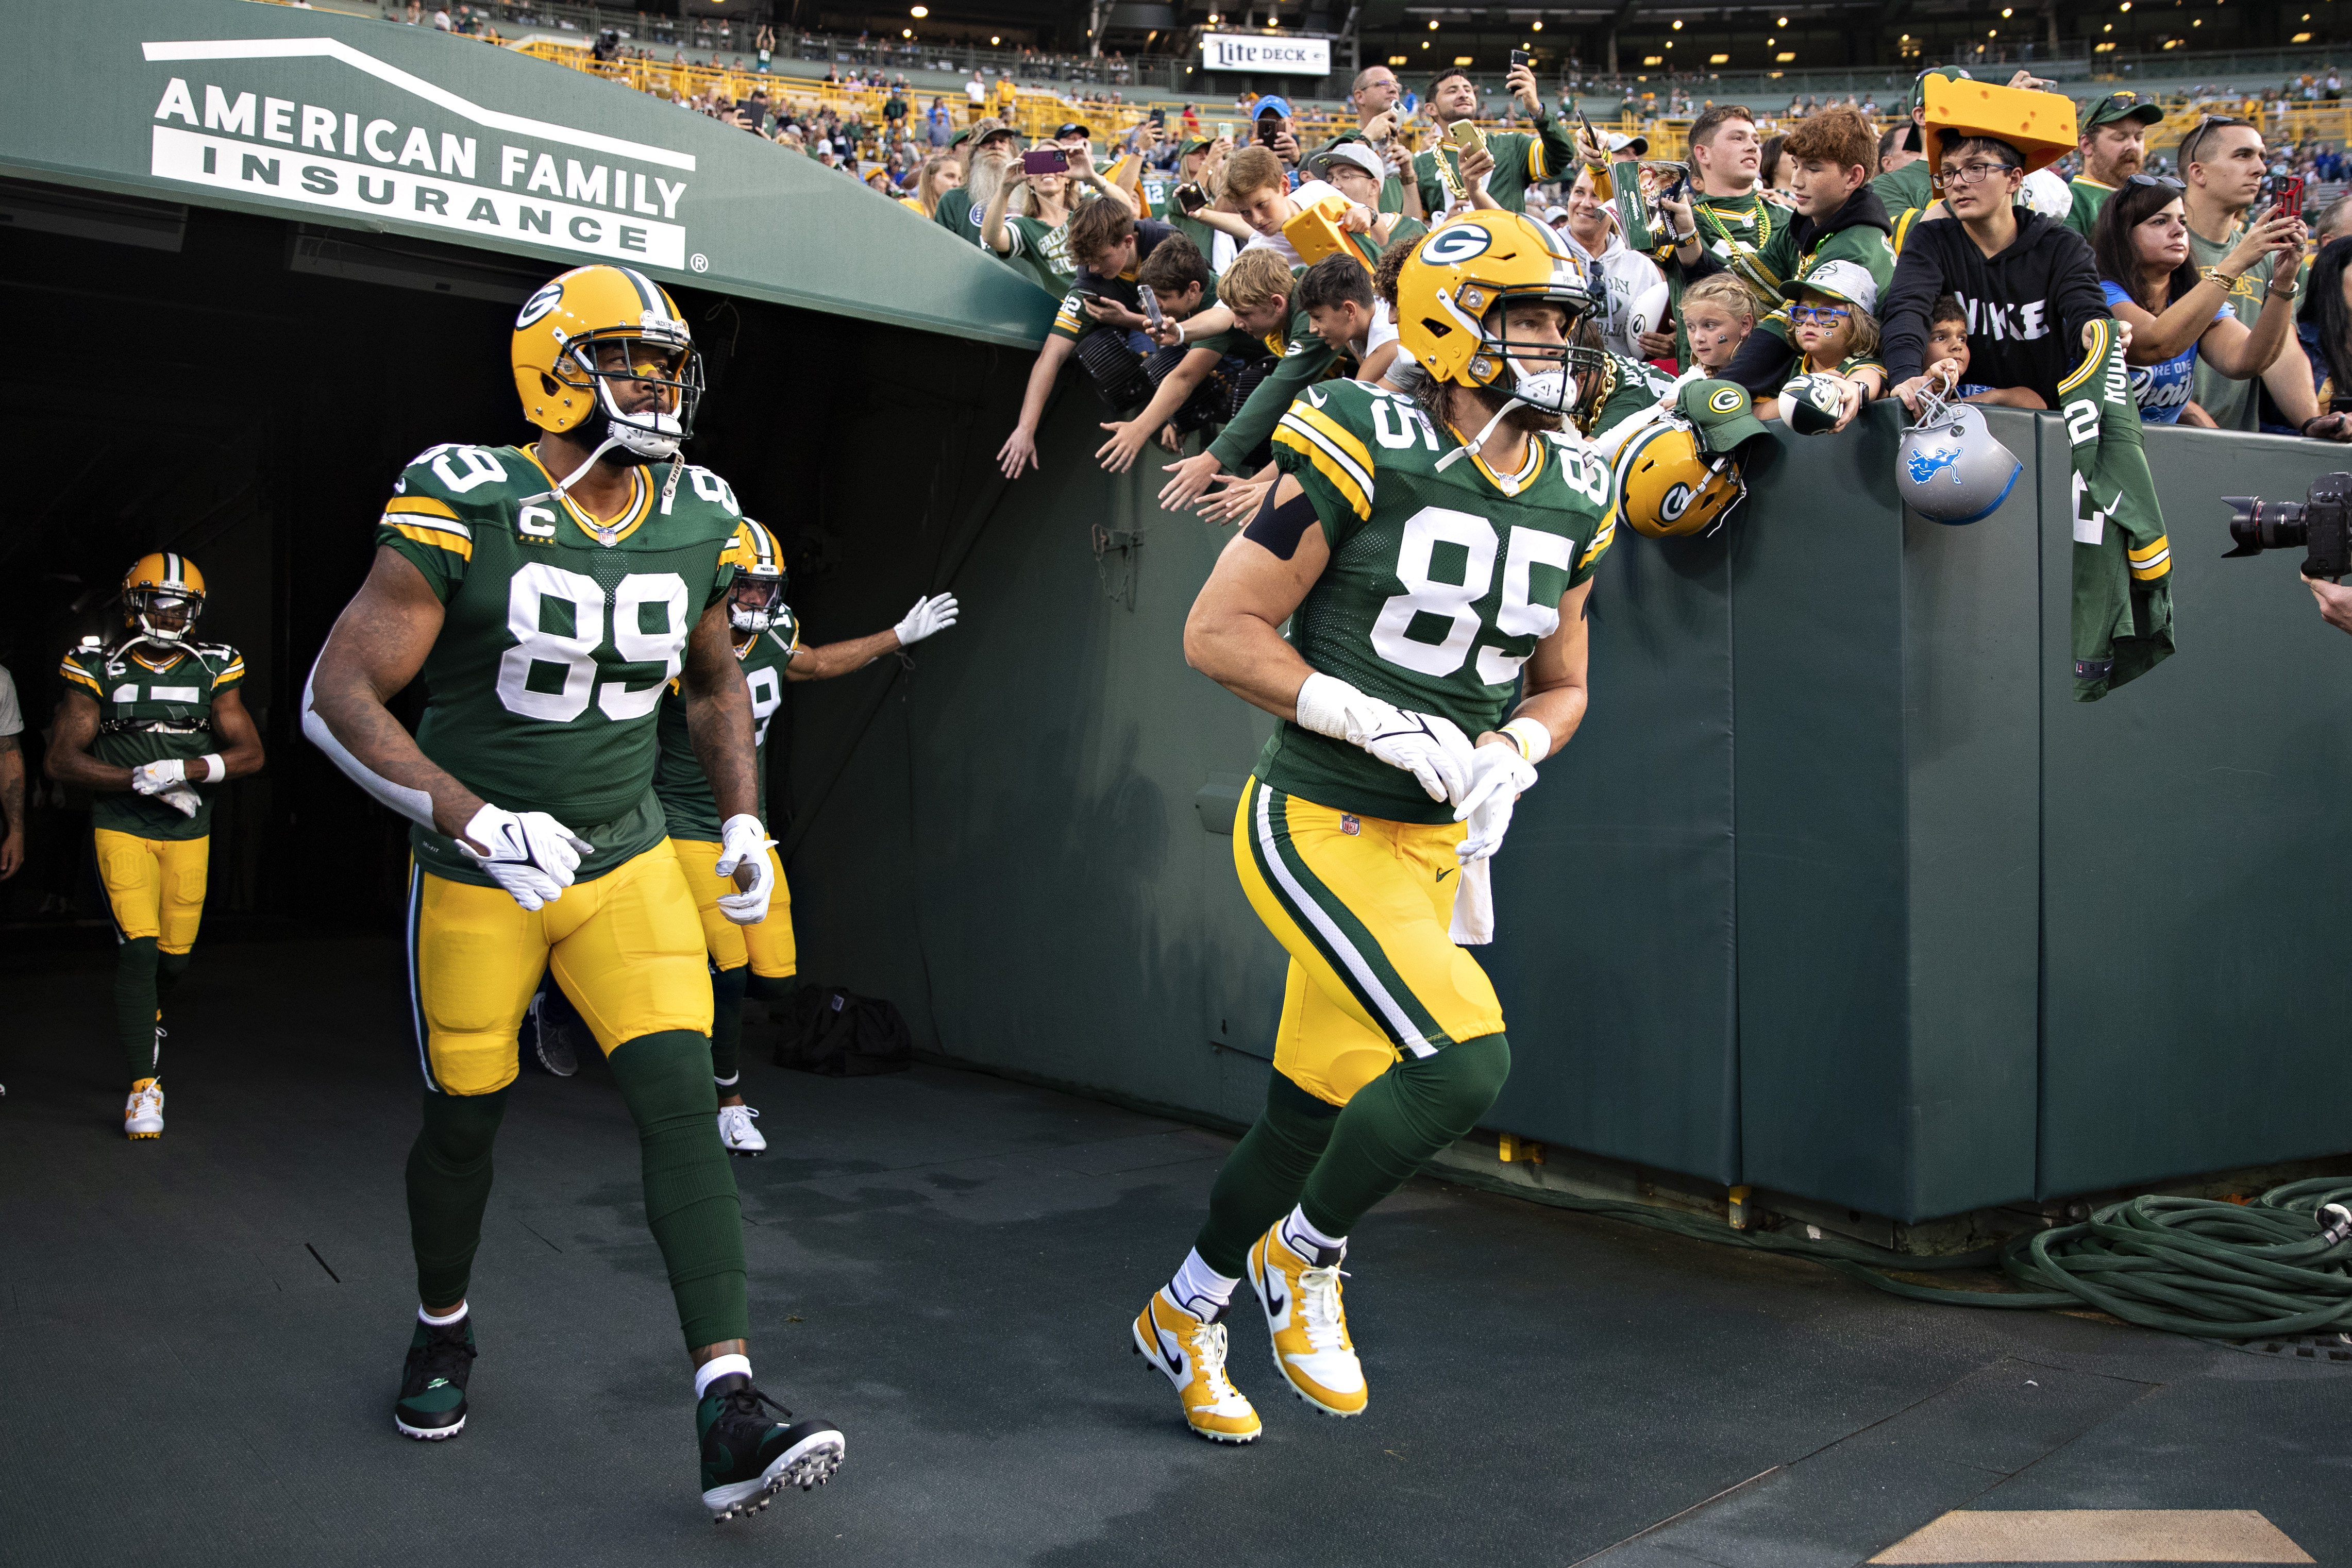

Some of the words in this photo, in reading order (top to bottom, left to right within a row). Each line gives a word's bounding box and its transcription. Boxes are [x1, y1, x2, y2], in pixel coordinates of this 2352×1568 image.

[1219, 42, 1256, 65] Lite
[1263, 48, 1305, 60] DECK
[155, 77, 477, 179] AMERICAN
[501, 145, 687, 219] FAMILY
[204, 147, 647, 252] INSURANCE
[1685, 237, 1694, 245] GO
[2063, 398, 2099, 446] 2
[520, 507, 556, 536] C
[601, 533, 615, 543] NFL
[1370, 506, 1575, 686] 85
[495, 562, 688, 722] 89
[746, 666, 782, 747] 9
[1344, 821, 1357, 833] NFL
